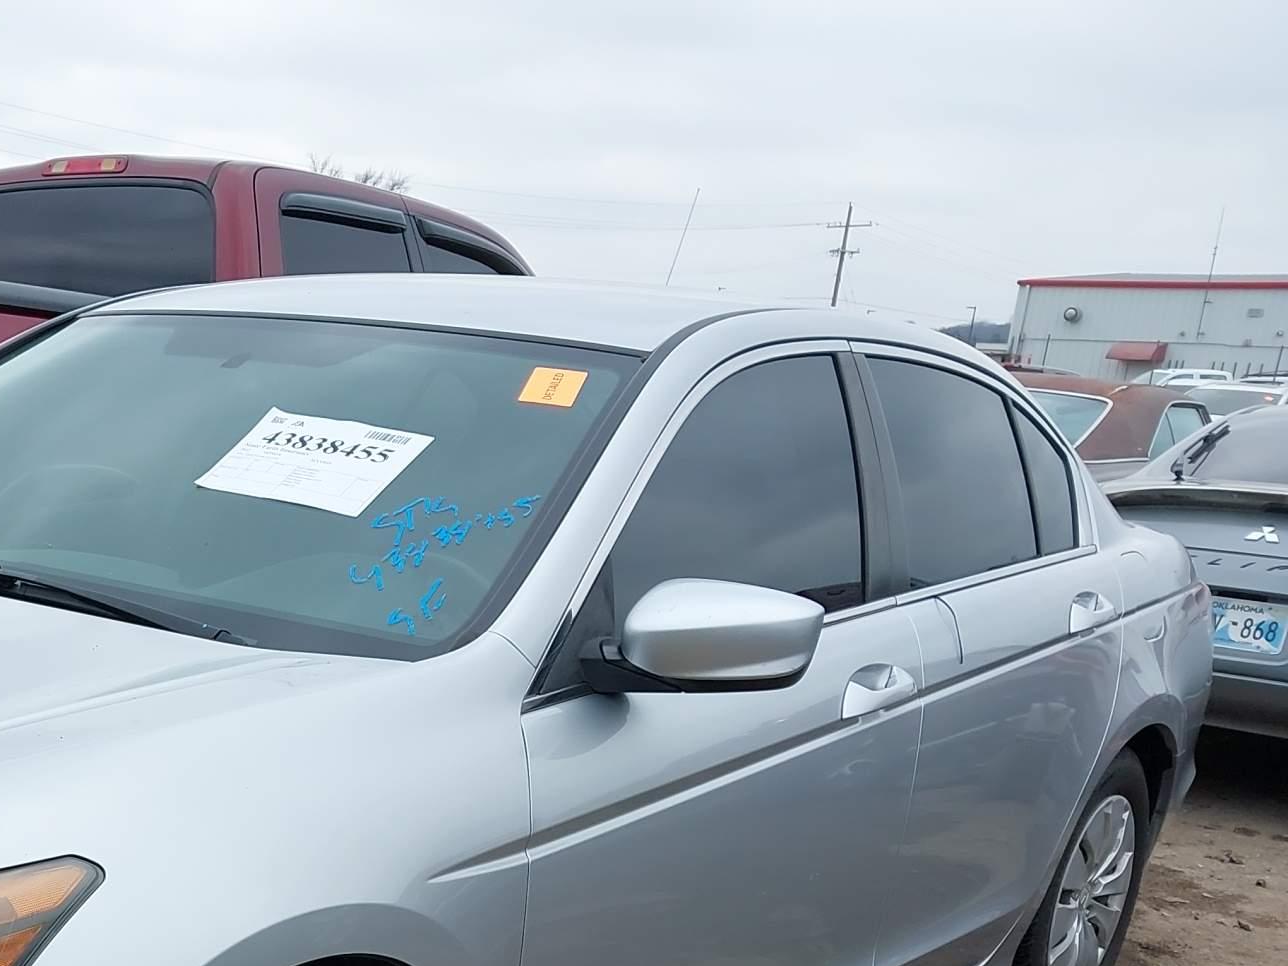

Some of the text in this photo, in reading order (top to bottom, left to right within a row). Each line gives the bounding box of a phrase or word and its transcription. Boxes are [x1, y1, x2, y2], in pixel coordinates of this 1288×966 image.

[542, 372, 565, 401] DETAILED
[262, 430, 396, 464] 43838455
[1212, 600, 1265, 615] OKLAHOMA
